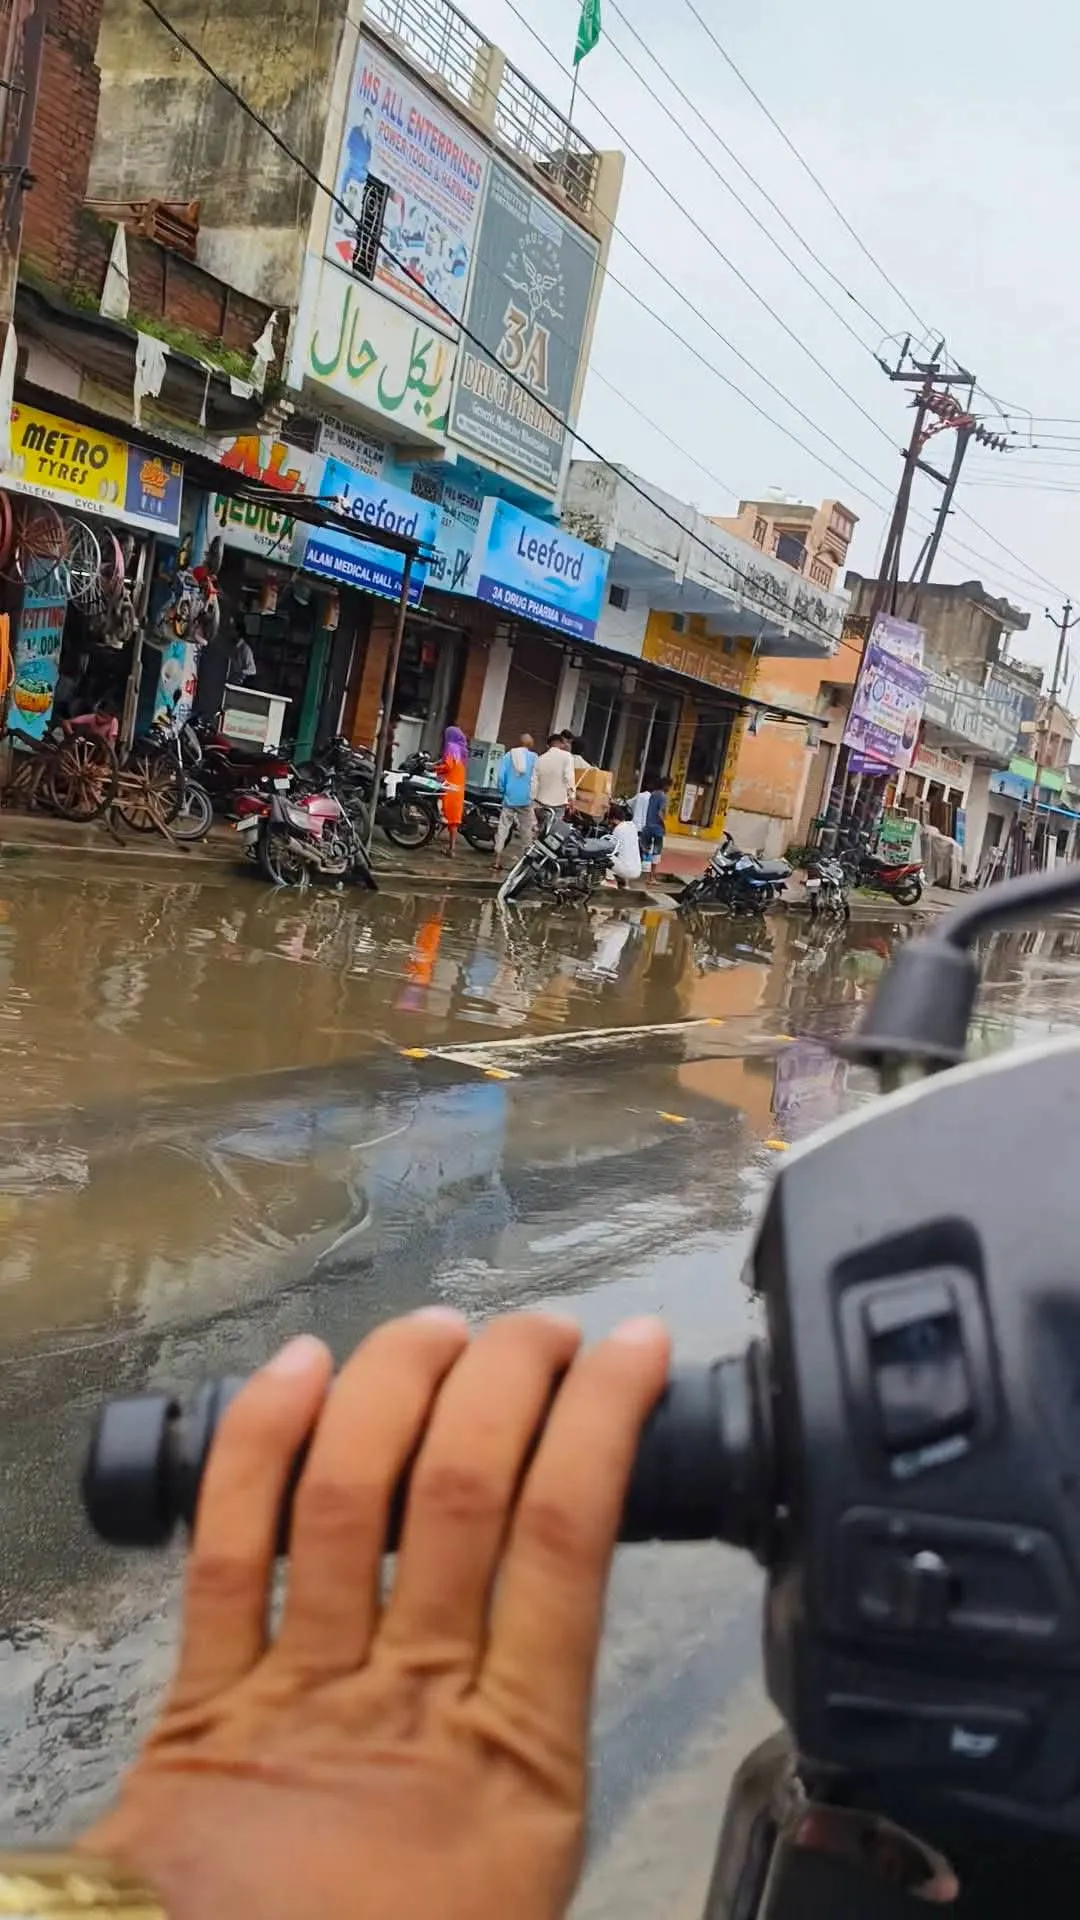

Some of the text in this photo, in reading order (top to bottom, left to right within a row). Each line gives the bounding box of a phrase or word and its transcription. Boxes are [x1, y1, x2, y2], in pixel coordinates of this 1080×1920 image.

[381, 87, 403, 127] ALL
[407, 107, 482, 190] ENTERPRISES
[496, 298, 550, 395] 3A
[462, 351, 508, 410] DRUG
[508, 379, 564, 446] PHARMA
[21, 422, 109, 470] METRO
[38, 457, 89, 485] TYRES
[16, 482, 104, 513] SALEEM CYCLE
[342, 483, 418, 537] Leeford
[307, 549, 392, 589] ALAM MEDICAL HALL
[517, 525, 584, 580] Leeford
[492, 586, 503, 601] 3A
[504, 590, 527, 609] DRUG
[527, 600, 560, 622] PHARMA
